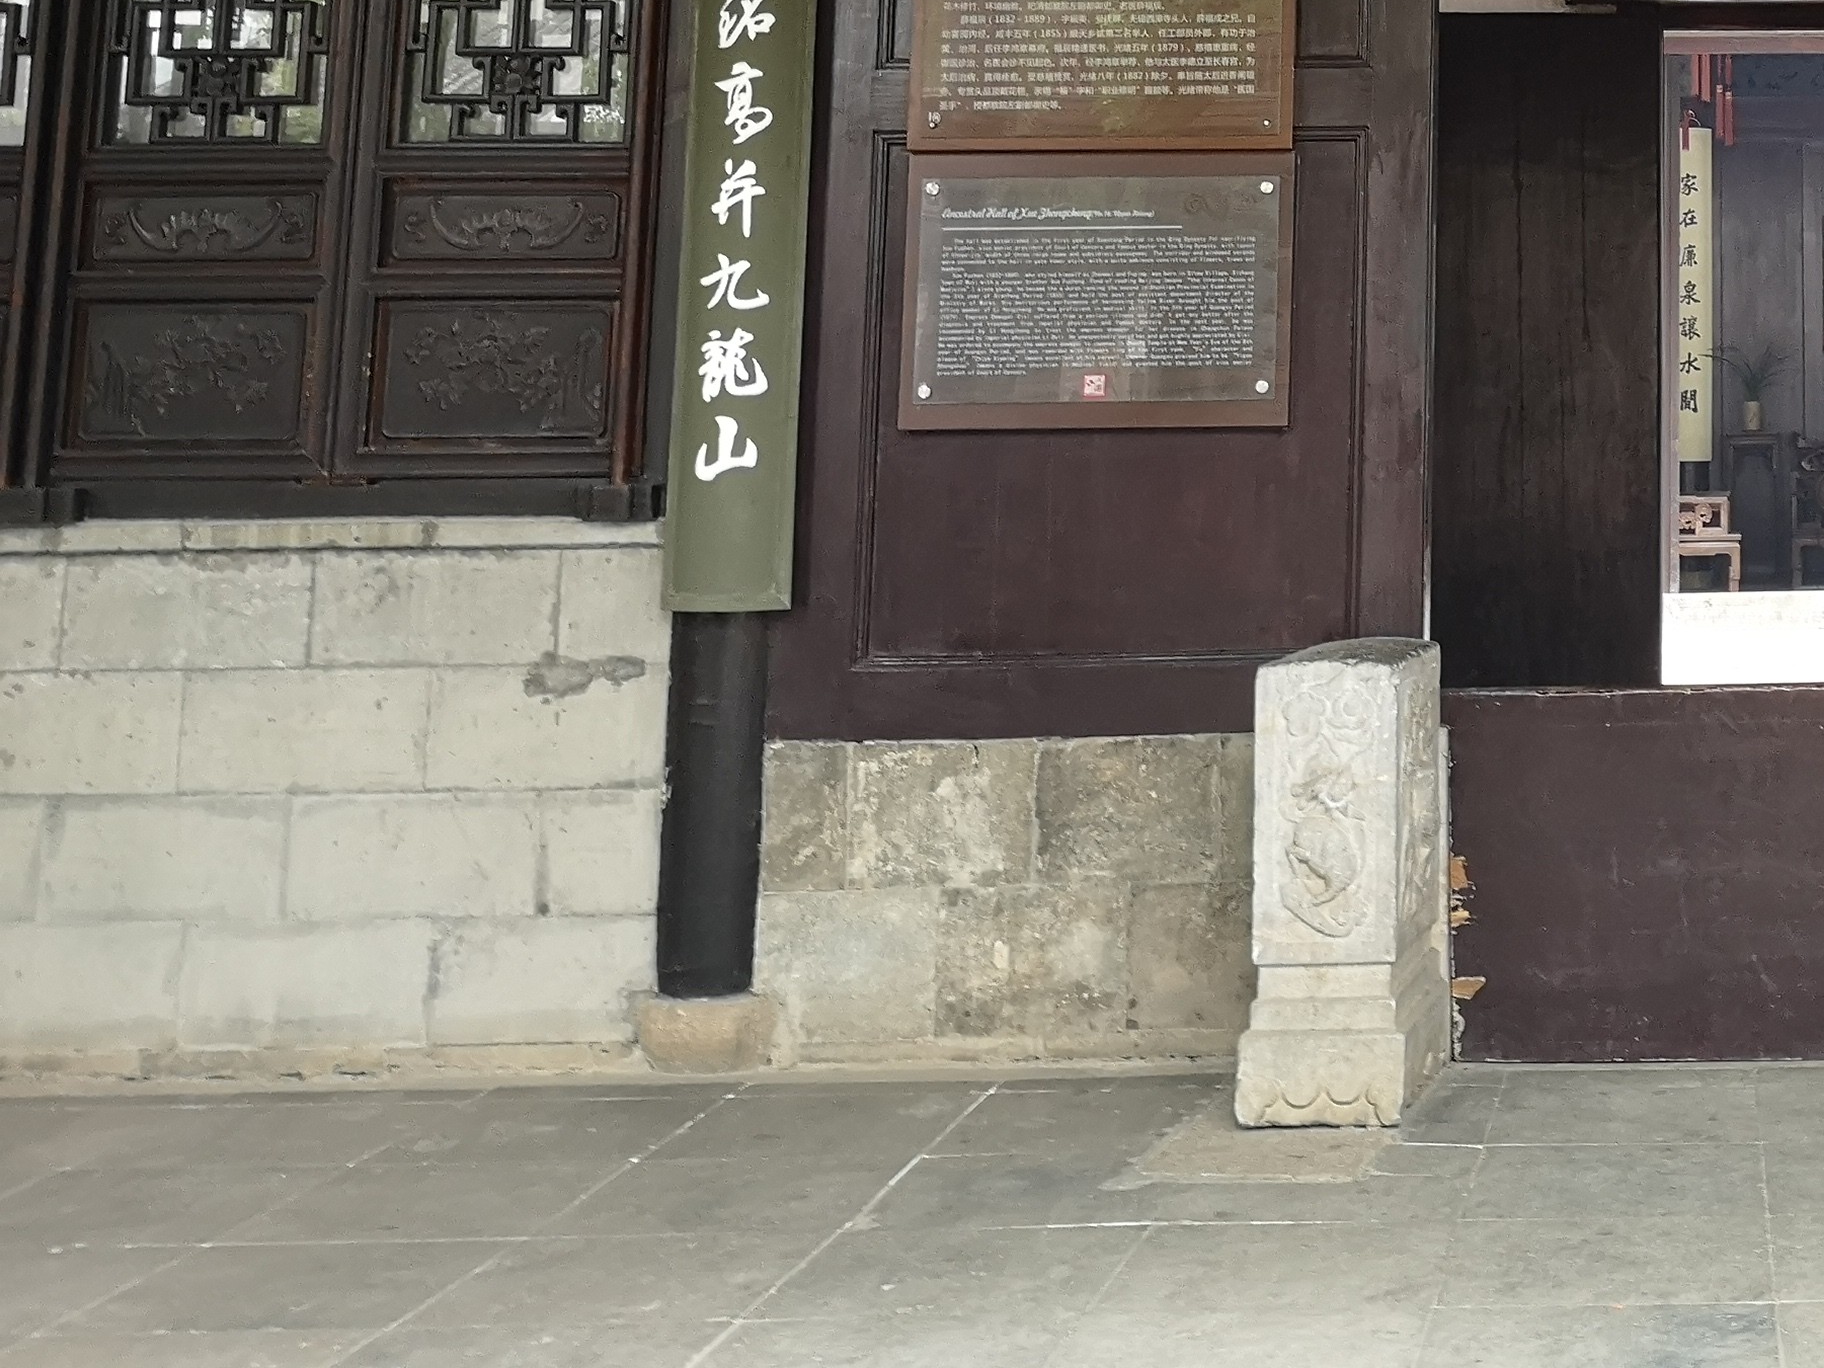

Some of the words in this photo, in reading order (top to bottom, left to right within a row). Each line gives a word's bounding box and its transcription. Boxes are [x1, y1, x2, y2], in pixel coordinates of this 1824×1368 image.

[1679, 172, 1702, 414] 家在廉泉讓水間
